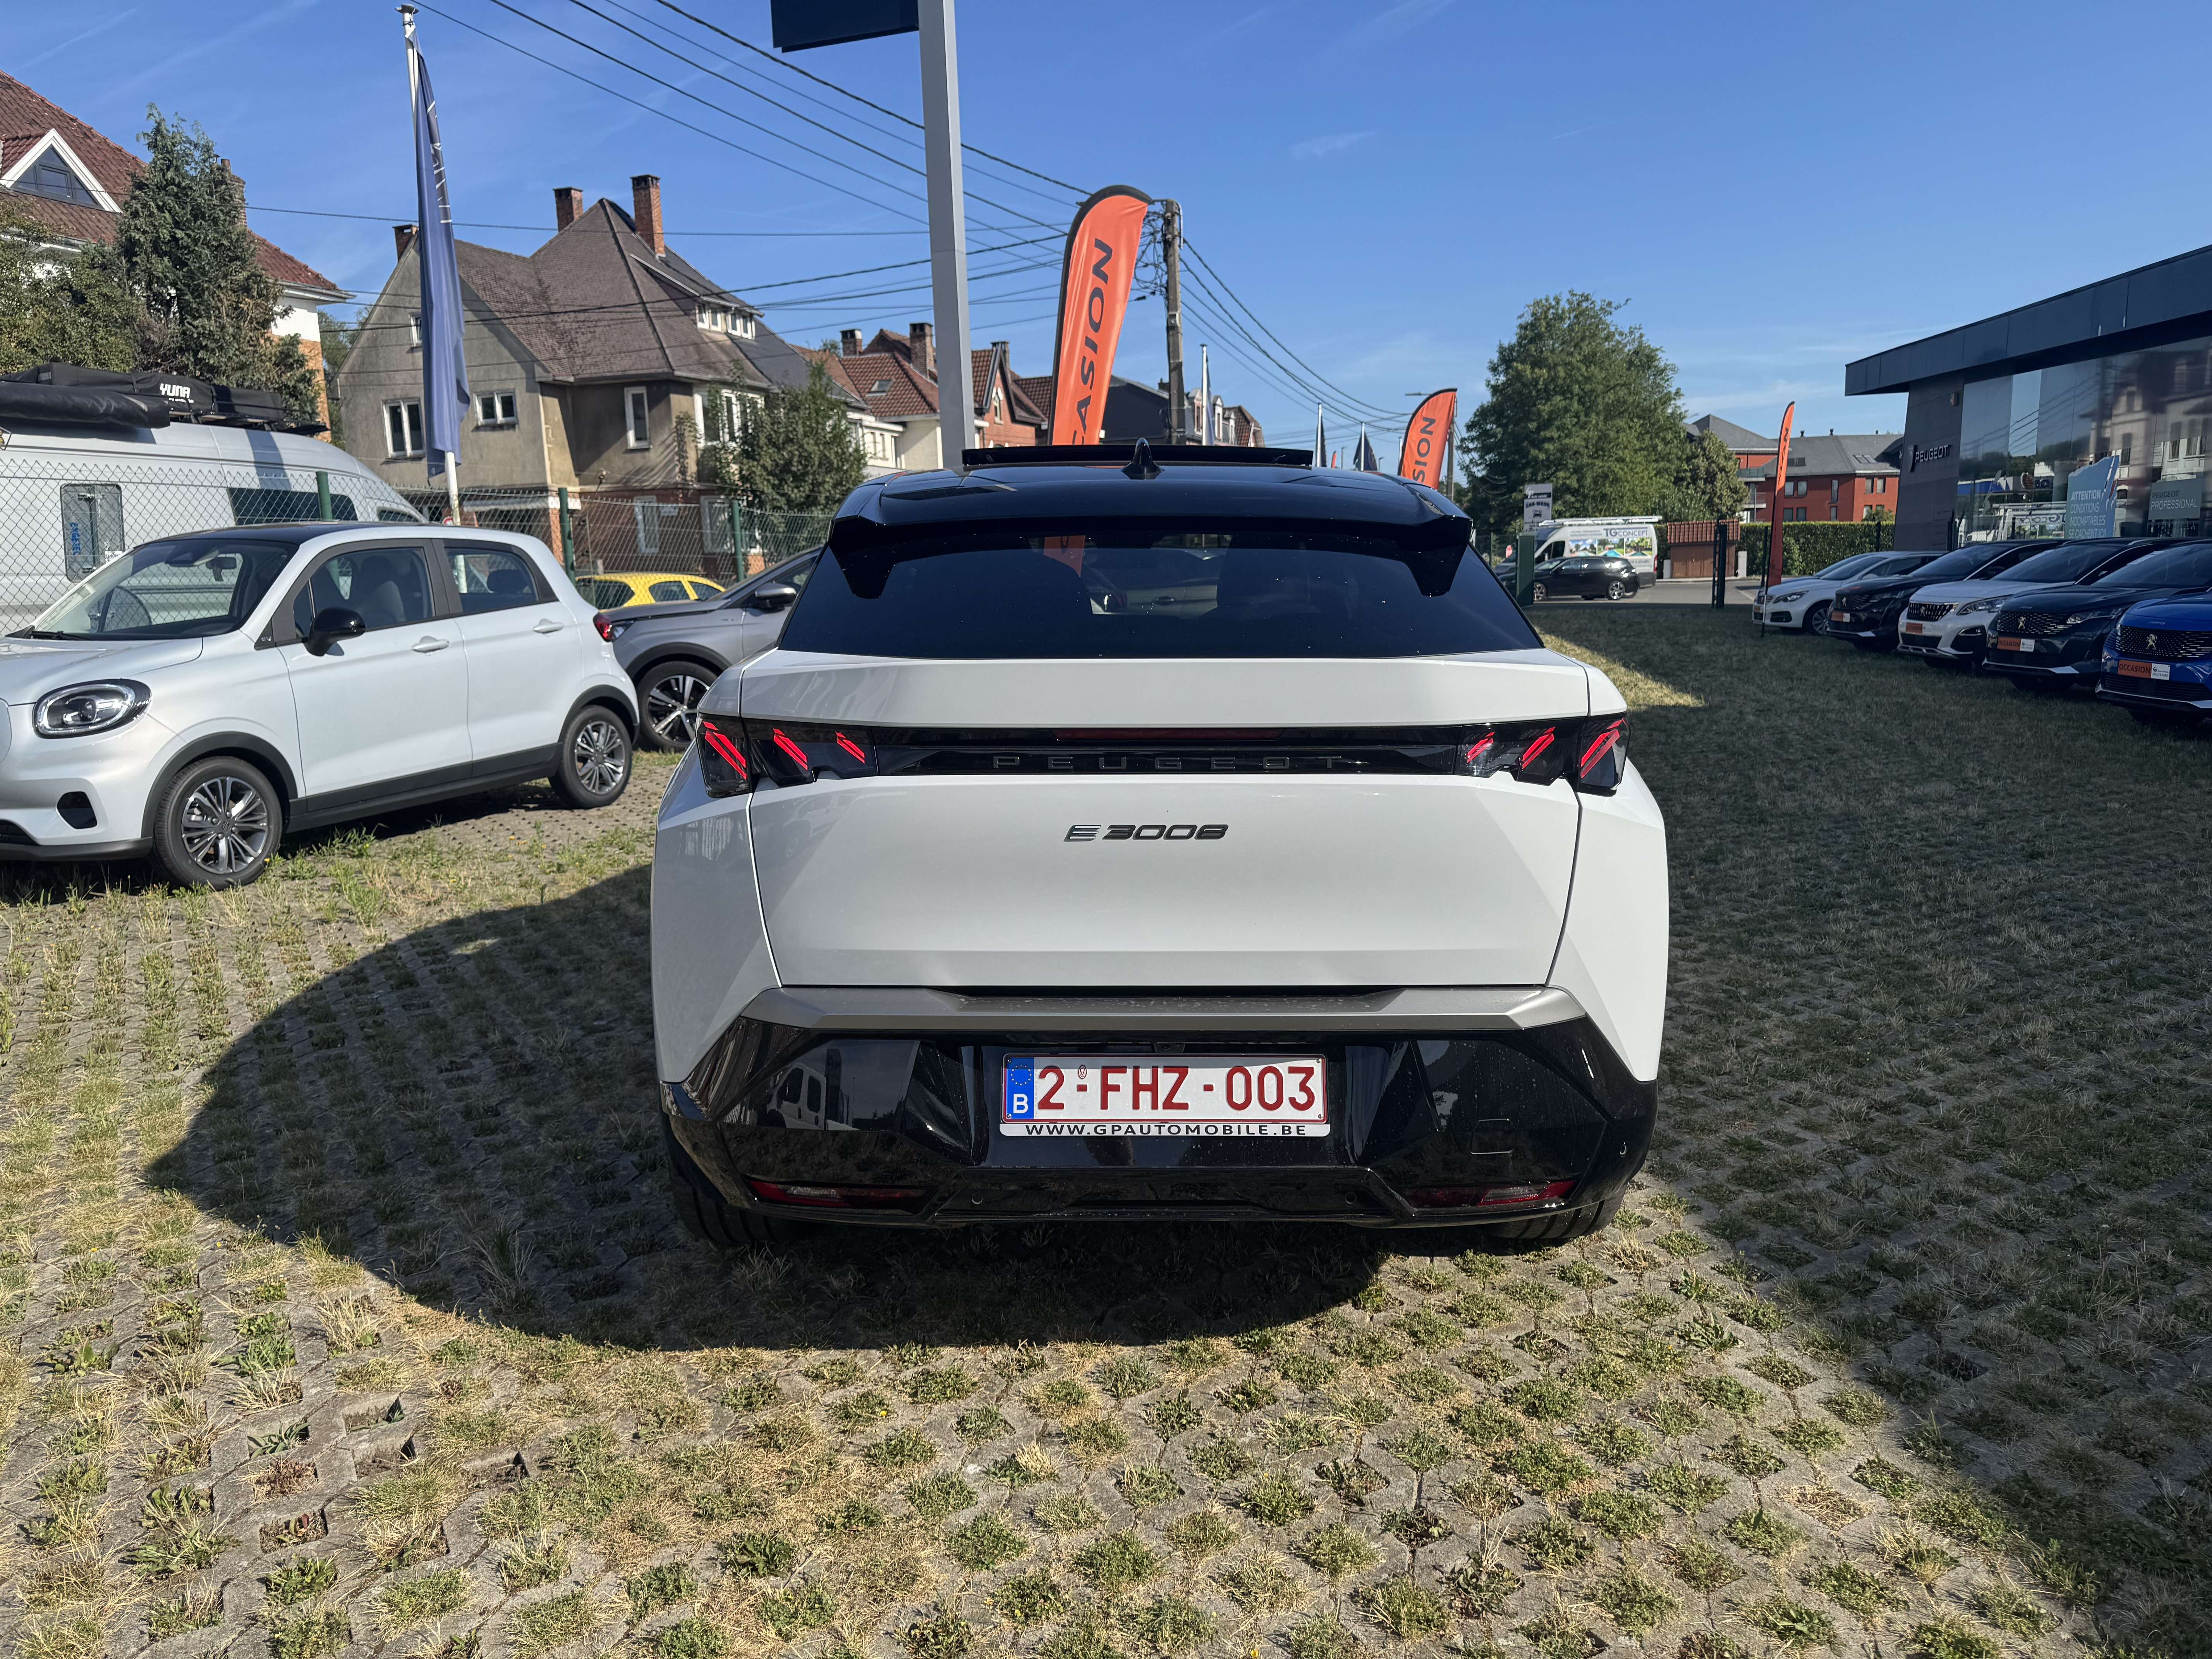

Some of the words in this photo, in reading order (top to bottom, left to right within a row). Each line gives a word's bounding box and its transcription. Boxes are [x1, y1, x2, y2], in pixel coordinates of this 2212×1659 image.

[160, 383, 190, 398] YUNA
[1915, 445, 1948, 463] PEUGEOT
[2071, 489, 2101, 501] ATTENTION
[2152, 490, 2179, 498] PEUGEOT
[2070, 503, 2099, 514] CONDITIONS
[2151, 499, 2197, 510] PROFESSIONAL
[2069, 515, 2106, 526] INDOMPTABLES
[2068, 529, 2075, 539] SE
[2119, 664, 2150, 673] OCCASION
[993, 756, 1341, 770] PEUGEOT
[1063, 825, 1101, 841] E
[1103, 824, 1228, 840] 3008
[1038, 1066, 1315, 1111] 2-FHZ-003
[1013, 1094, 1029, 1114] B
[1026, 1124, 1307, 1135] WWW.GPAUTOMOBILE.BE
